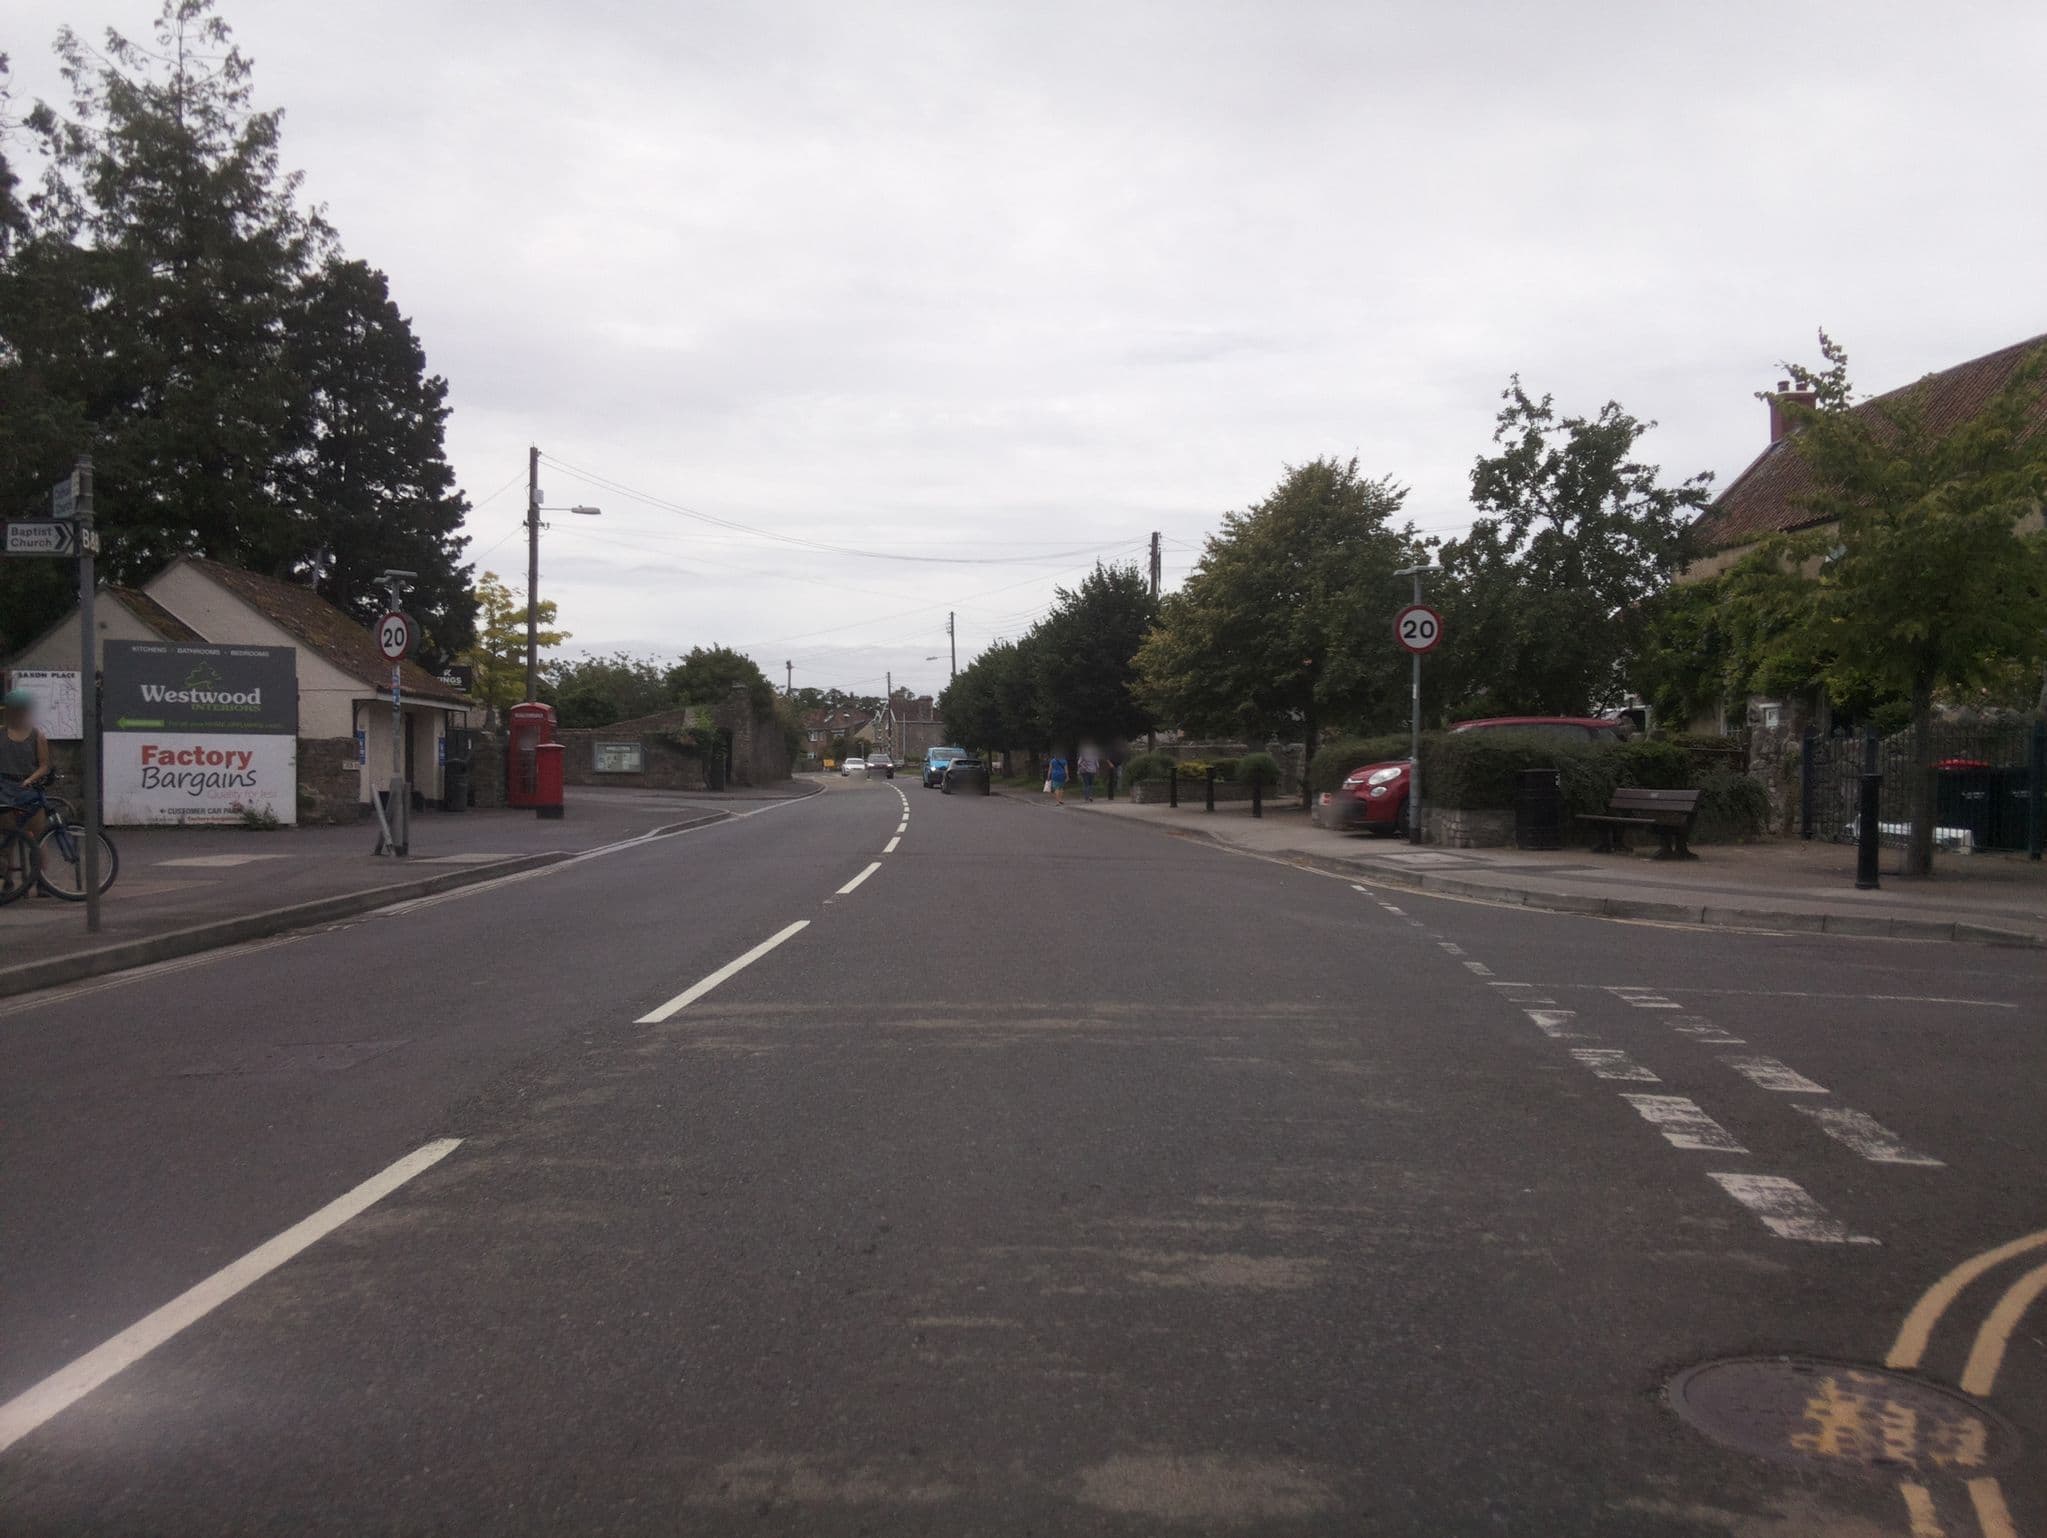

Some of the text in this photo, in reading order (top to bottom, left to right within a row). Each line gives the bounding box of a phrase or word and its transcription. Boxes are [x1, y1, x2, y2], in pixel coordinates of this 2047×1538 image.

[11, 527, 53, 537] Baptist
[11, 538, 52, 547] Church
[1403, 620, 1435, 639] 20
[383, 627, 405, 648] 20
[132, 646, 167, 654] KITCHENS
[141, 684, 261, 705] Westwood
[192, 703, 261, 711] INTERIORS
[141, 745, 253, 770] Factory
[142, 766, 256, 797] Bargains
[168, 807, 206, 815] CUSTOMER
[207, 807, 222, 815] CAR
